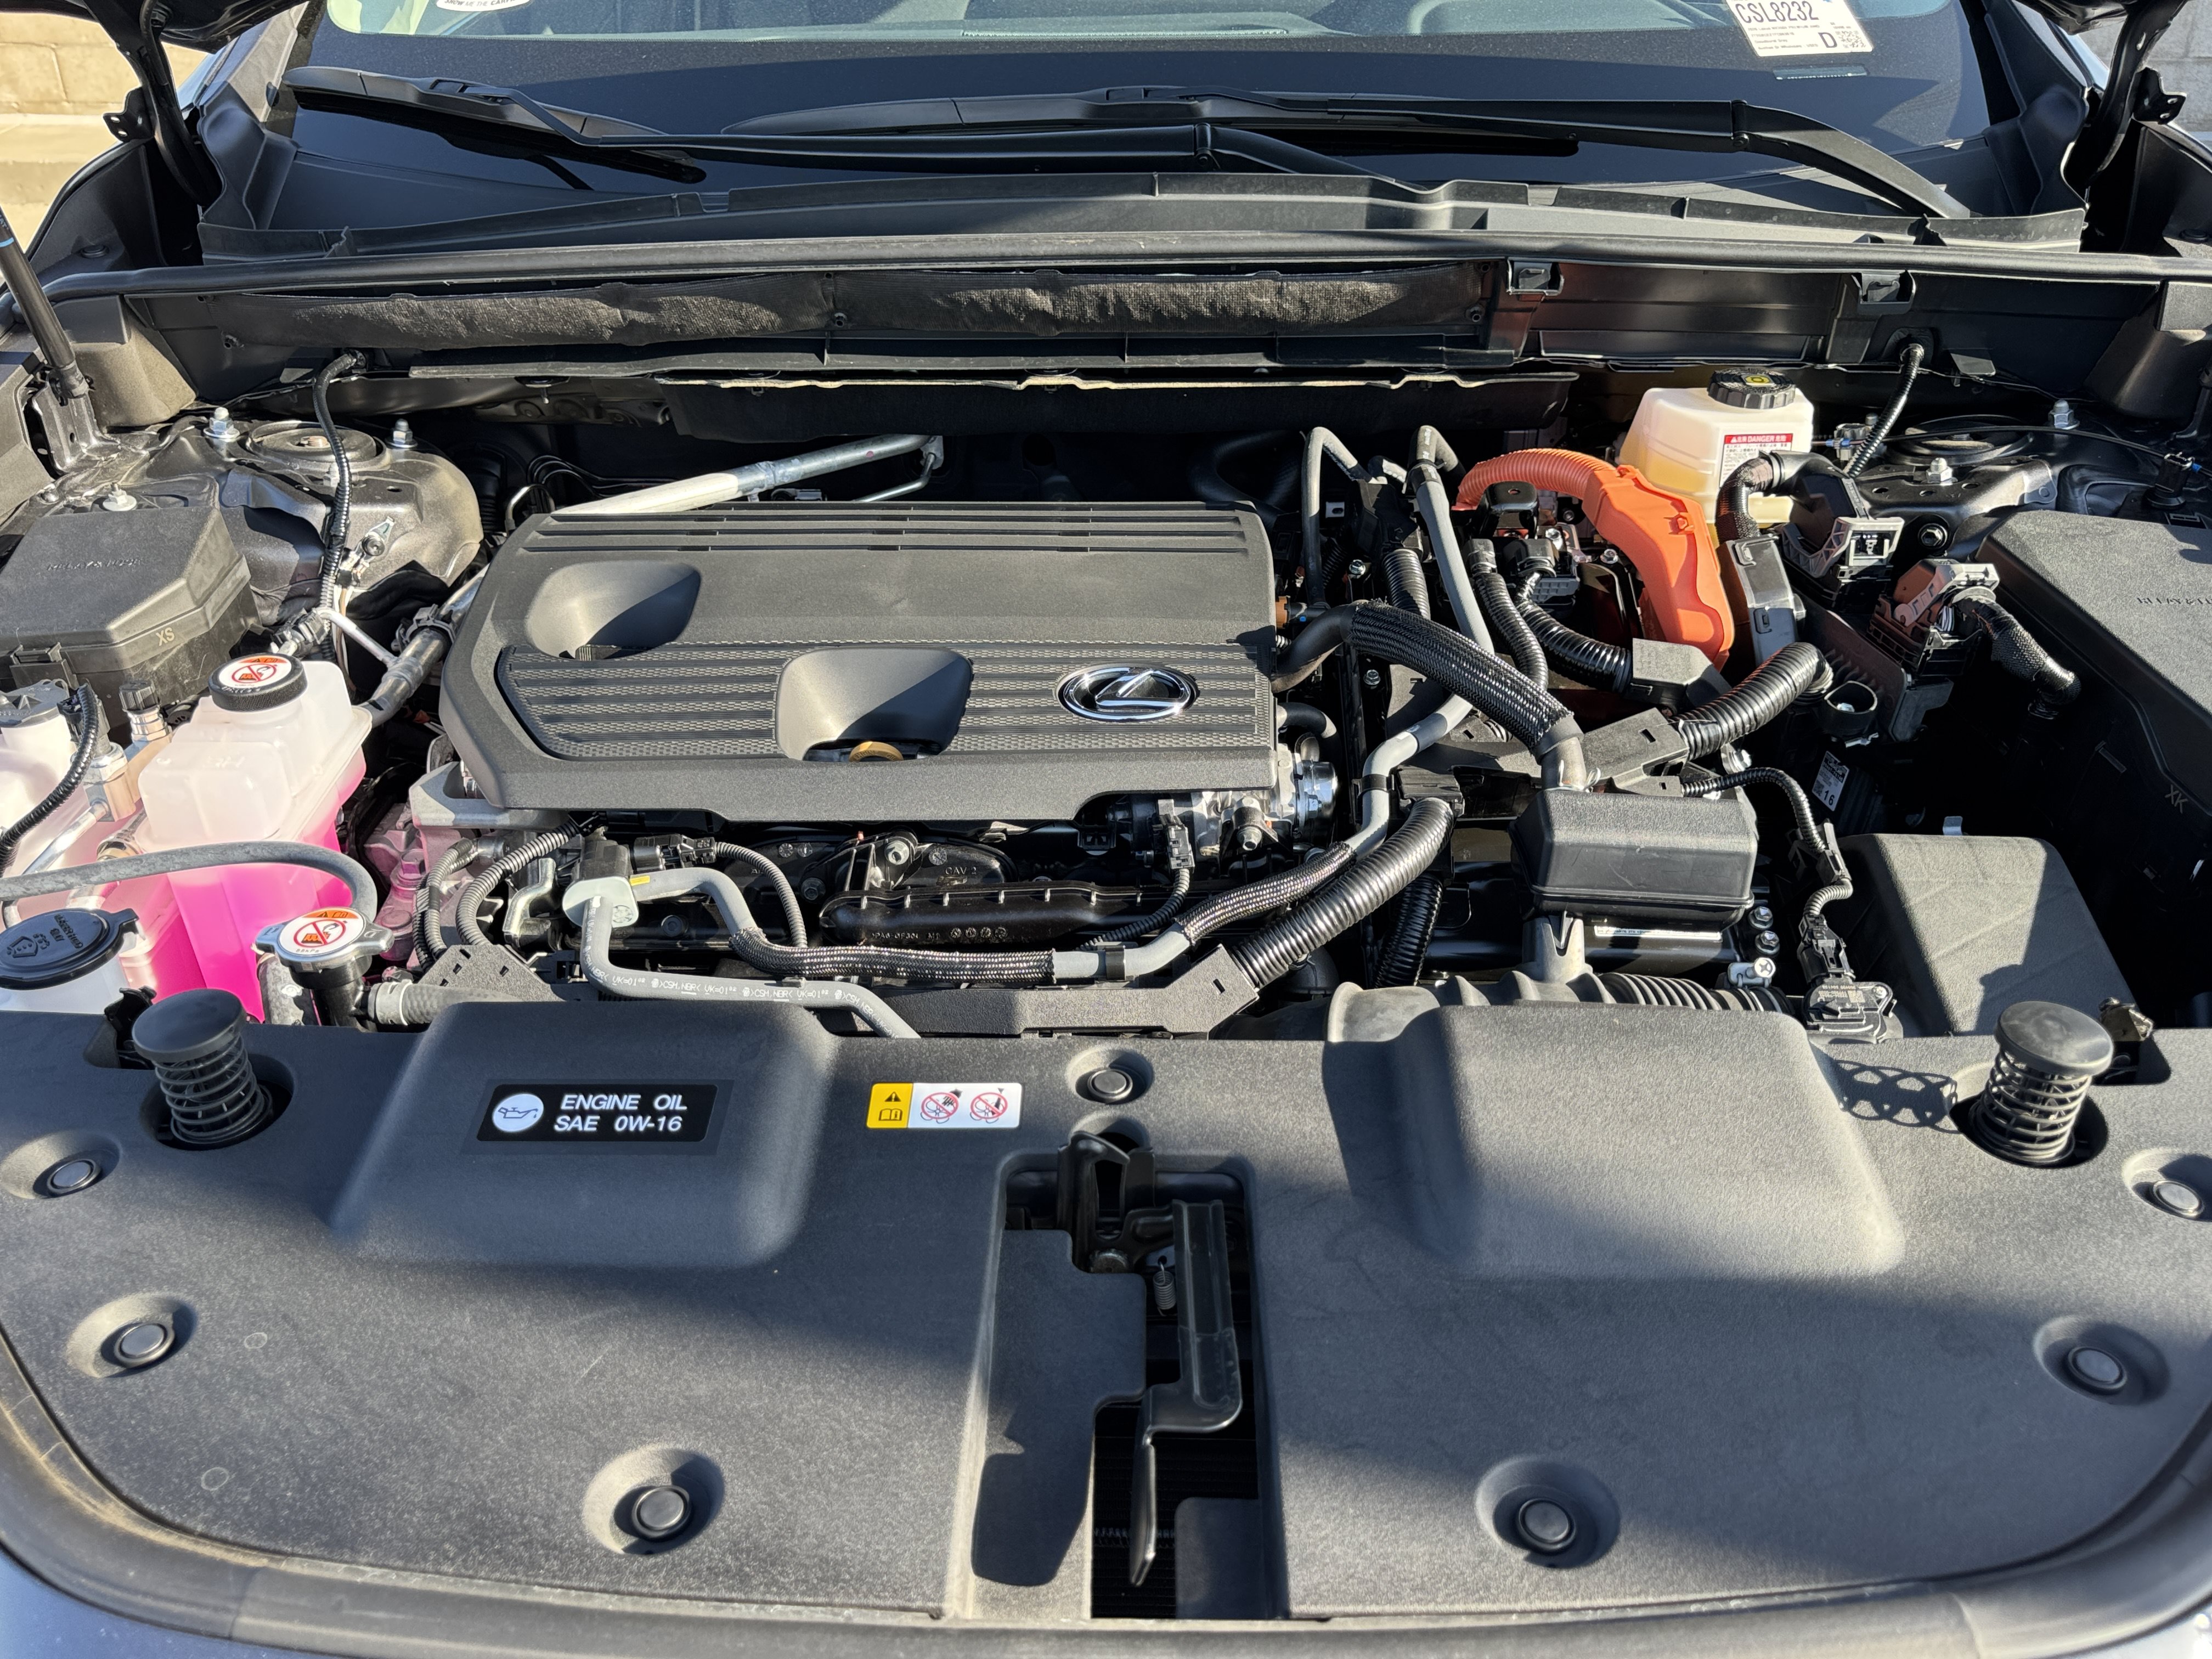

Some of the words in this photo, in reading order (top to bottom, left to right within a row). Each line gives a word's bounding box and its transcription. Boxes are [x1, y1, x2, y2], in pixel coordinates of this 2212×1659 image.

[1735, 1, 1820, 23] CSL8232
[1818, 32, 1838, 48] D
[156, 627, 175, 646] XS
[1824, 790, 1835, 806] 16
[2164, 784, 2188, 814] XK
[560, 1094, 641, 1110] ENGINE
[652, 1094, 687, 1110] OIL
[554, 1114, 601, 1132] SAE
[613, 1114, 683, 1132] 0W-16
